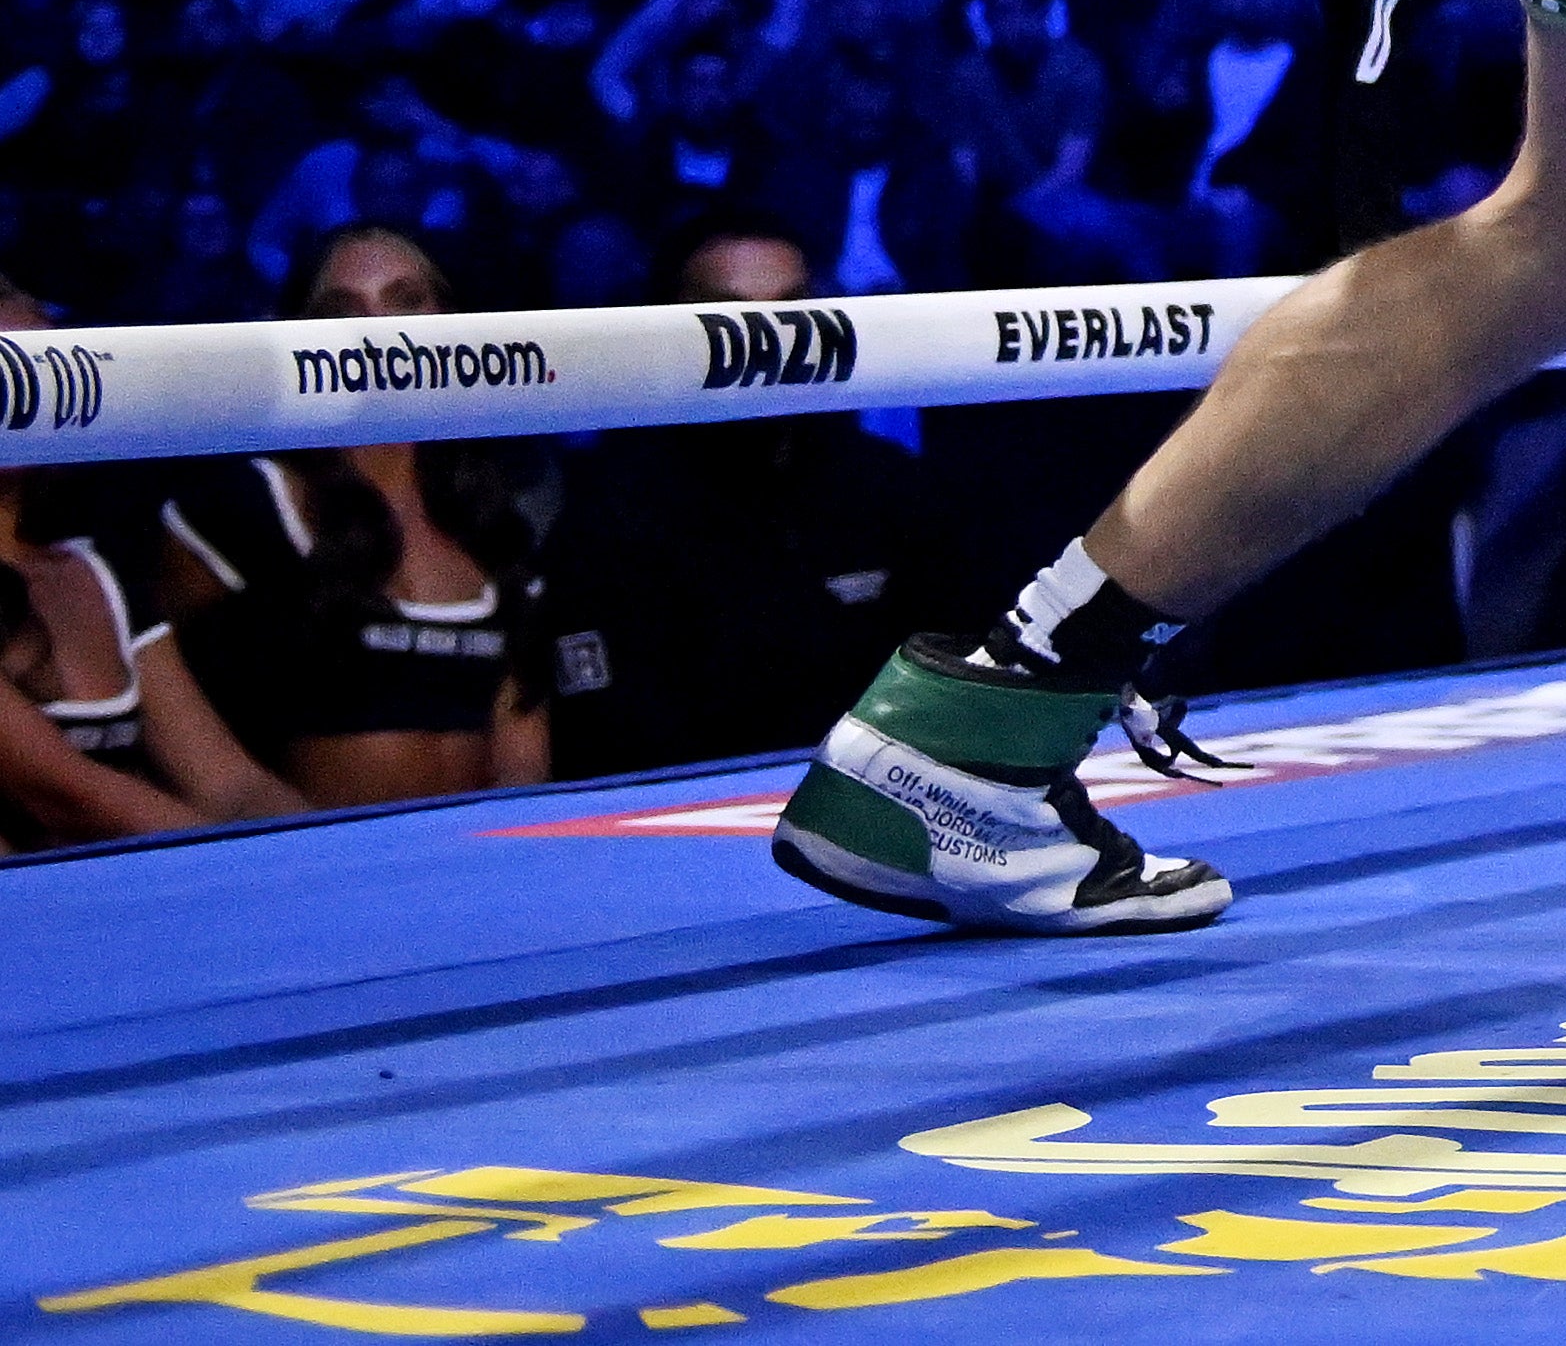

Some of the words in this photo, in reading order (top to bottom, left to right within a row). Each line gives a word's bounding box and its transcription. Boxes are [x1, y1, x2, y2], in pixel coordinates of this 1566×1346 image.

[292, 330, 557, 395] matchroom.
[696, 308, 859, 391] DAZN
[994, 303, 1216, 364] EVERLAST
